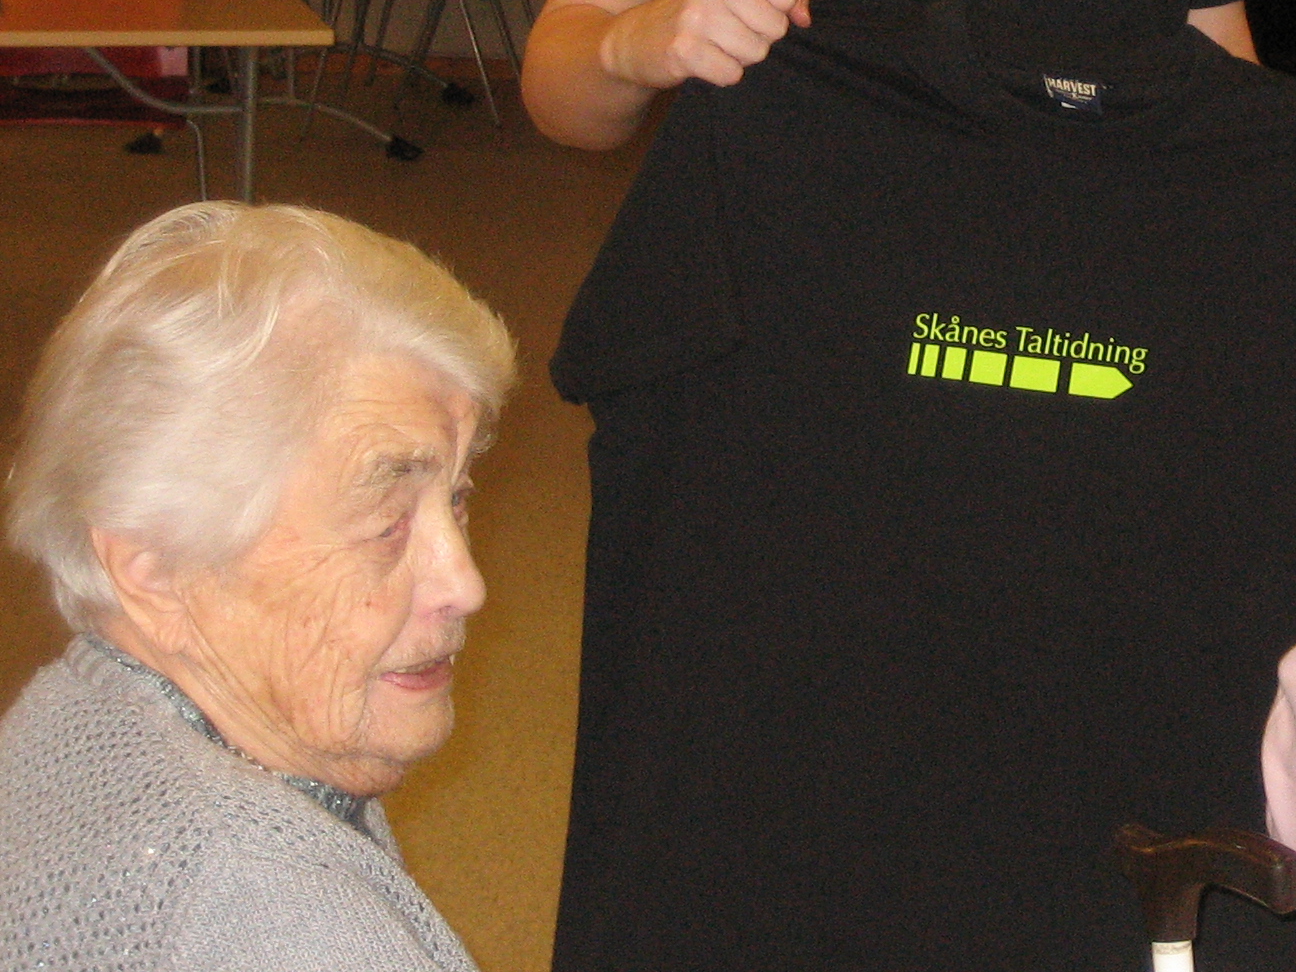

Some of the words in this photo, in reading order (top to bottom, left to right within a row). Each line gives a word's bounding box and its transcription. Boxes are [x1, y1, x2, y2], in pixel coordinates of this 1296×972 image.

[1047, 78, 1097, 97] HARVEST
[912, 312, 1008, 349] Skånes
[1015, 325, 1149, 375] Taltidning
